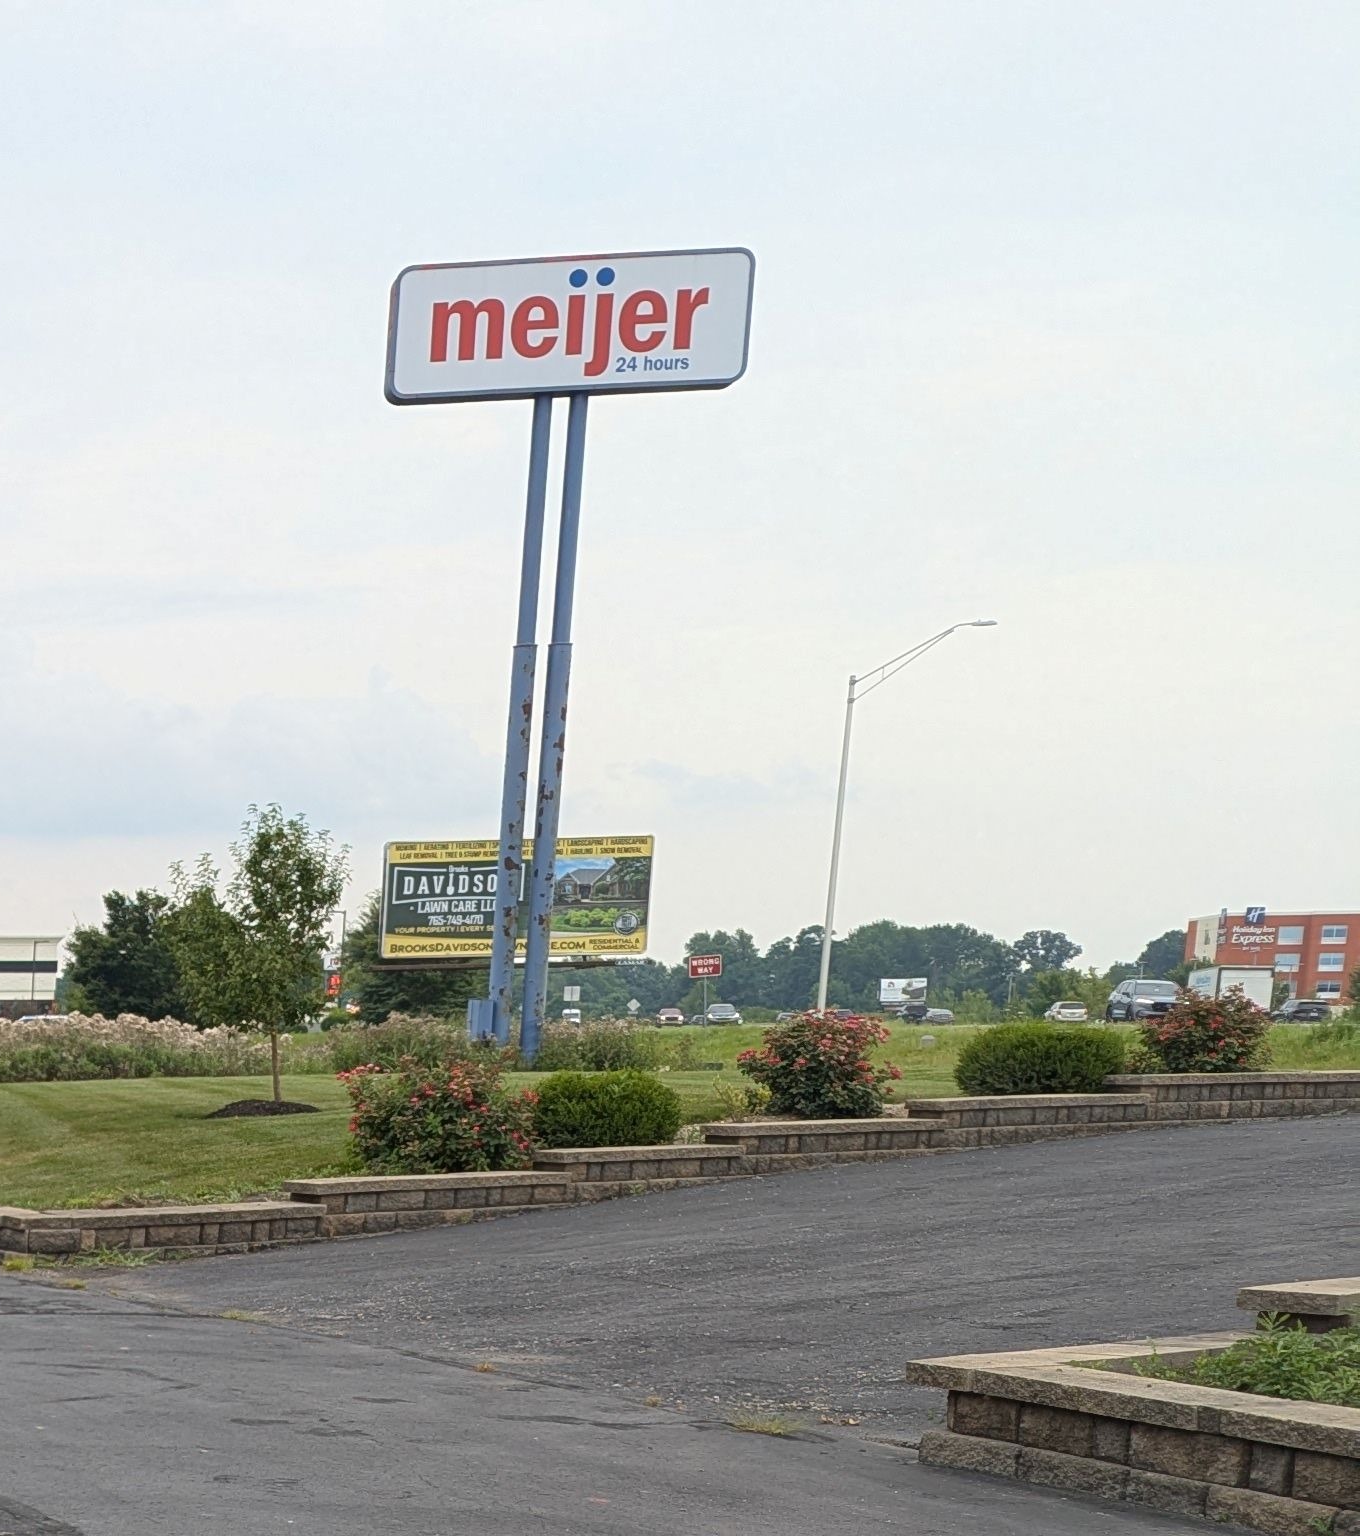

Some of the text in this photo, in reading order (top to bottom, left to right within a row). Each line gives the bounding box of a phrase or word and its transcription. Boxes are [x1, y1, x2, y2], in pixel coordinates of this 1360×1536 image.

[429, 266, 710, 377] meijer
[615, 355, 690, 373] 24 hours
[402, 873, 498, 896] DAVIDSO
[417, 900, 449, 914] LAWN
[451, 900, 478, 913] CARE
[1231, 933, 1275, 946] Express
[691, 957, 720, 966] WRONG
[697, 966, 714, 974] WAY
